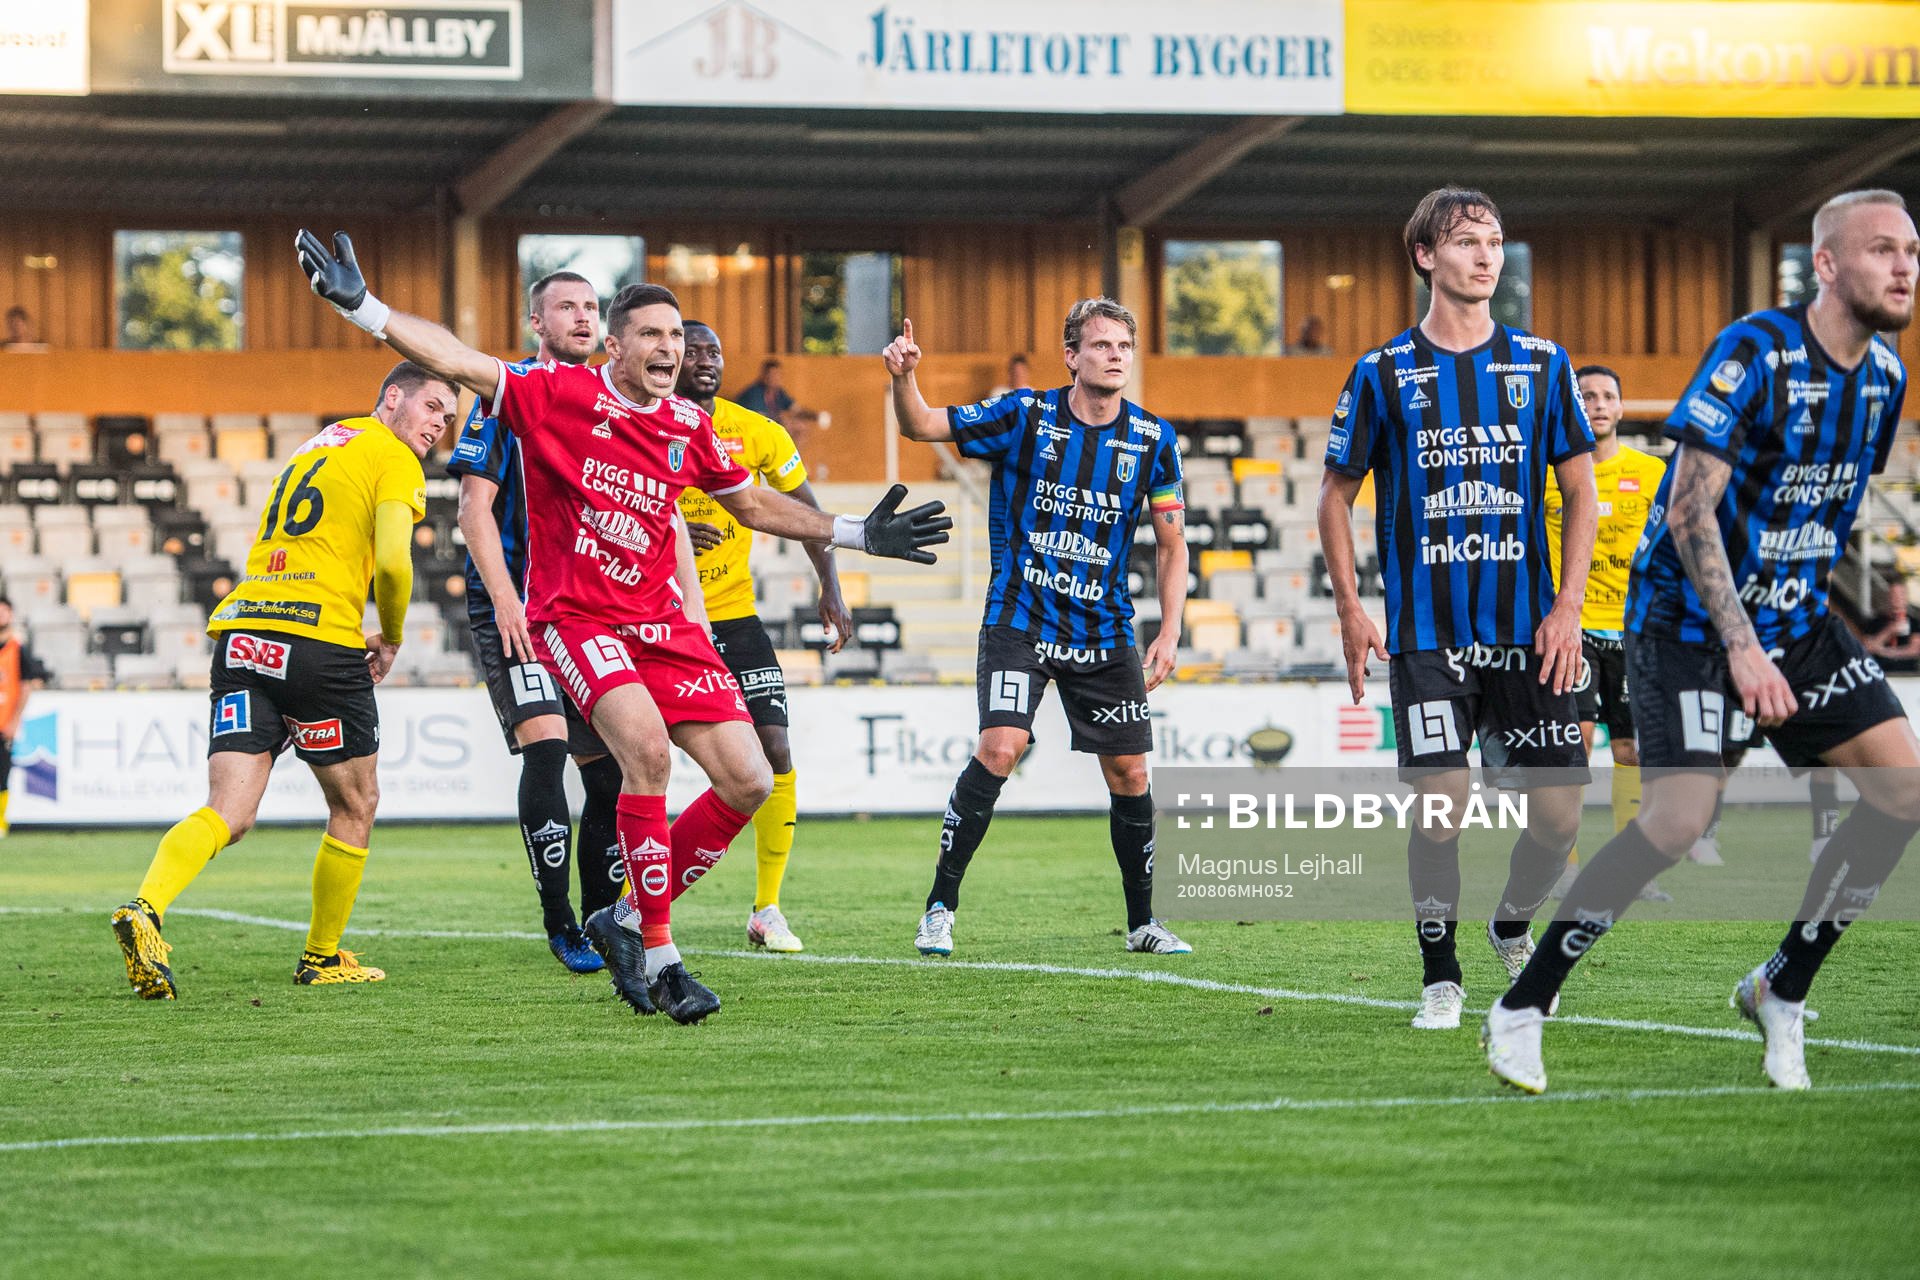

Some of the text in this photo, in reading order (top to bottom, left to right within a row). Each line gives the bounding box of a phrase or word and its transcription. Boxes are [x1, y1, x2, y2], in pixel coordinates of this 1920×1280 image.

[174, 2, 272, 61] XL
[296, 11, 496, 58] MJÄLLBY
[696, 4, 780, 81] JB
[858, 4, 1333, 79] JÄRLETOFT BYGGER
[1384, 340, 1416, 356] tmpl
[1408, 400, 1432, 410] SELECT
[1416, 427, 1468, 449] BYGG
[1417, 445, 1527, 469] CONSTRUCT
[582, 457, 629, 486] BYGG
[1781, 463, 1831, 483] BYGG
[262, 455, 325, 542] 16
[581, 473, 665, 516] CONSTRUCT
[1035, 478, 1078, 501] BYGG
[1421, 480, 1525, 511] BILDEMO
[1032, 495, 1123, 525] CONSTRUCT
[1423, 506, 1522, 520] DÄCK & SERVICECENTER
[1027, 530, 1113, 559] BILDEMO
[1420, 533, 1526, 566] inkClub
[266, 550, 288, 574] JB
[1052, 550, 1109, 566] SERVICECENTER
[1022, 558, 1105, 602] inkClub
[741, 670, 783, 687] LB-HUS
[291, 723, 337, 744] XTRA
[631, 853, 671, 862] SELECT
